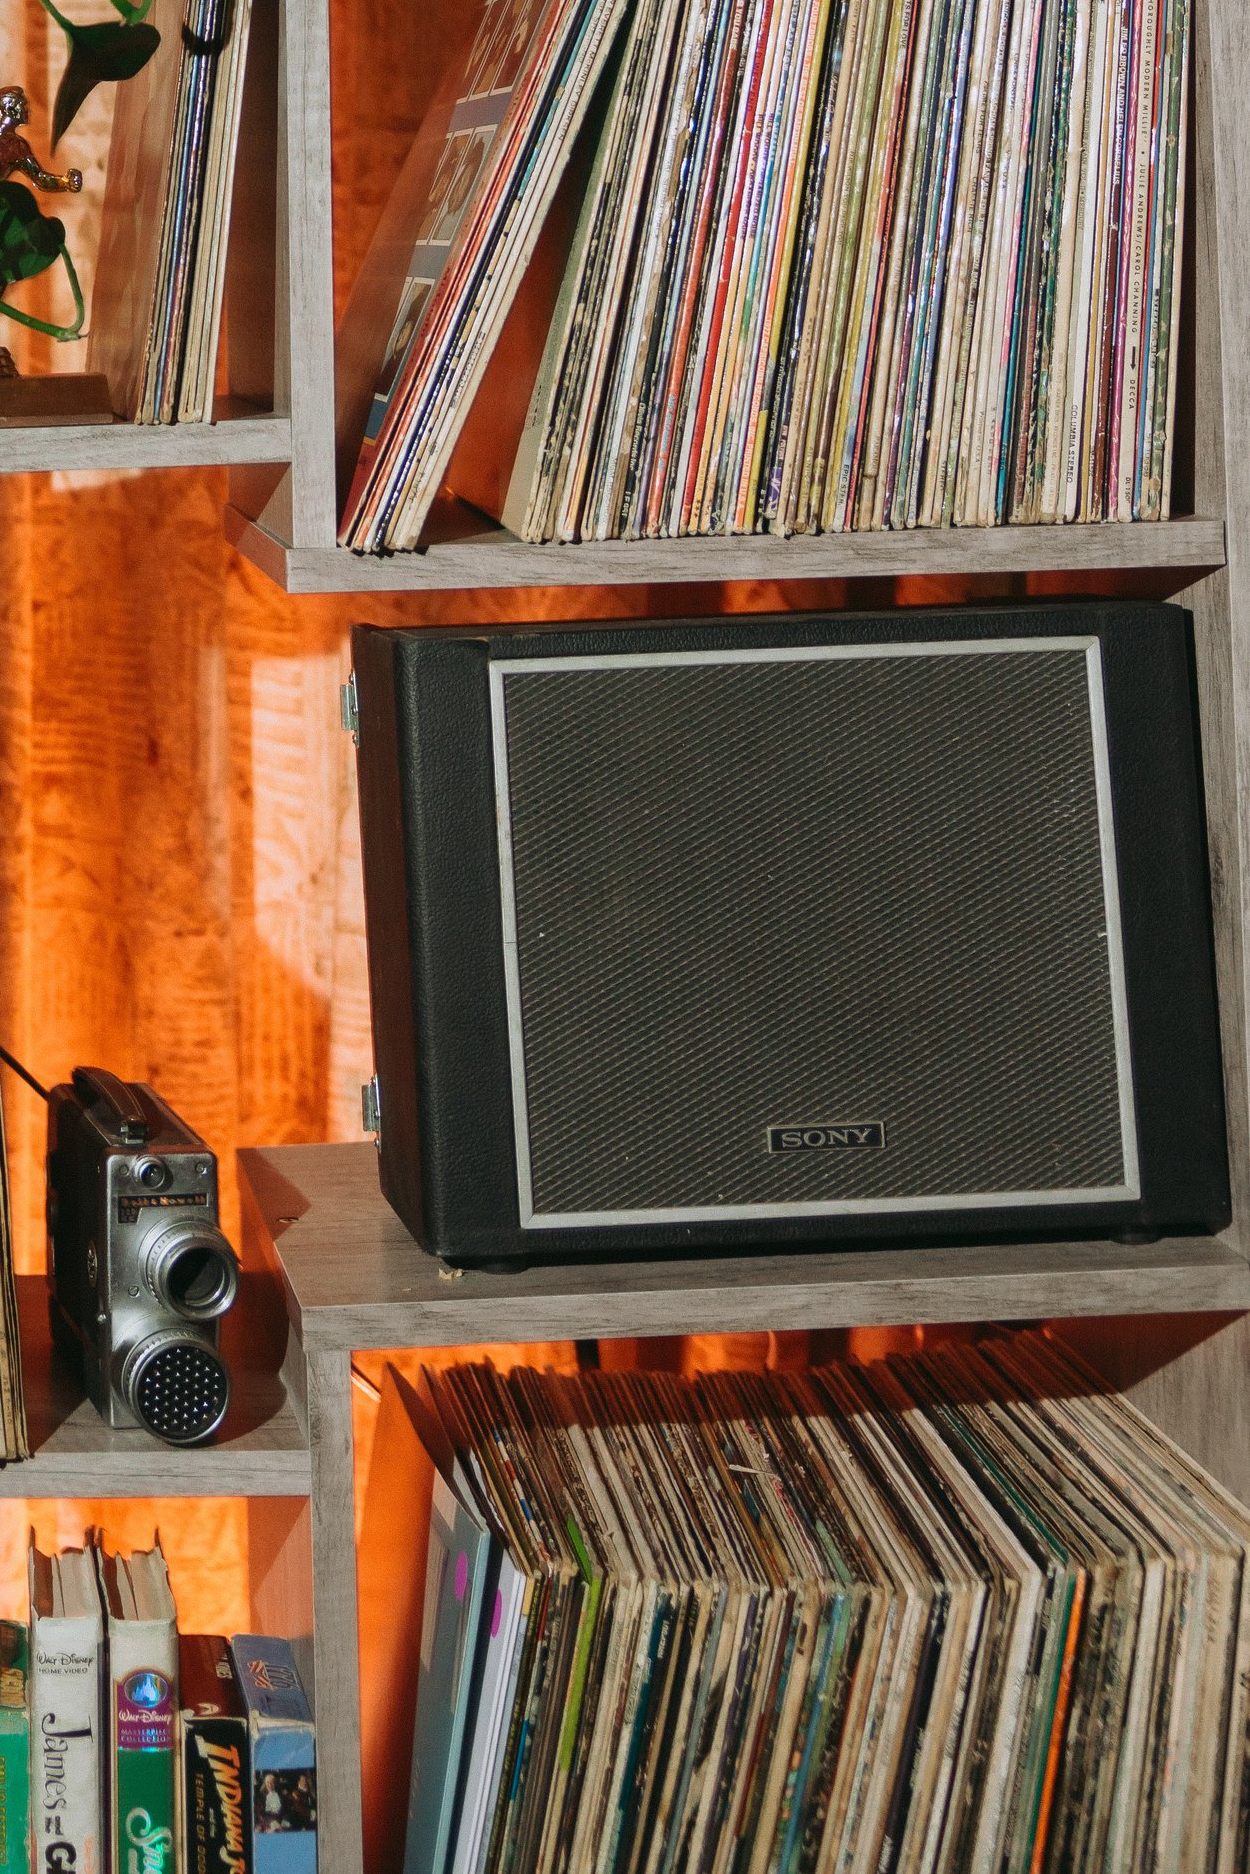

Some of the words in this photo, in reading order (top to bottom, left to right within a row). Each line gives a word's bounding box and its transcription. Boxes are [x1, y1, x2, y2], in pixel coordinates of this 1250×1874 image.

[902, 11, 910, 26] FOR
[899, 27, 908, 48] LOVE
[1118, 55, 1126, 87] BROWN
[1142, 60, 1150, 99] MODERN
[1133, 194, 1144, 276] ANDREWS/CAROL
[1130, 281, 1139, 333] CHANNING
[1127, 379, 1135, 410] DECCA
[629, 425, 642, 458] Records
[1068, 404, 1078, 448] COLUMBIA
[841, 464, 849, 482] EPIC
[1065, 449, 1075, 483] STEREO
[781, 1128, 872, 1148] SONY
[37, 1652, 58, 1666] Walt
[58, 1652, 94, 1667] Disney
[39, 1667, 63, 1675] HOME
[118, 1709, 141, 1723] Walt
[141, 1709, 173, 1725] Disney
[42, 1713, 93, 1810] James
[194, 1734, 246, 1852] INDIANA
[195, 1773, 205, 1820] TEMPLE
[196, 1825, 206, 1841] OF
